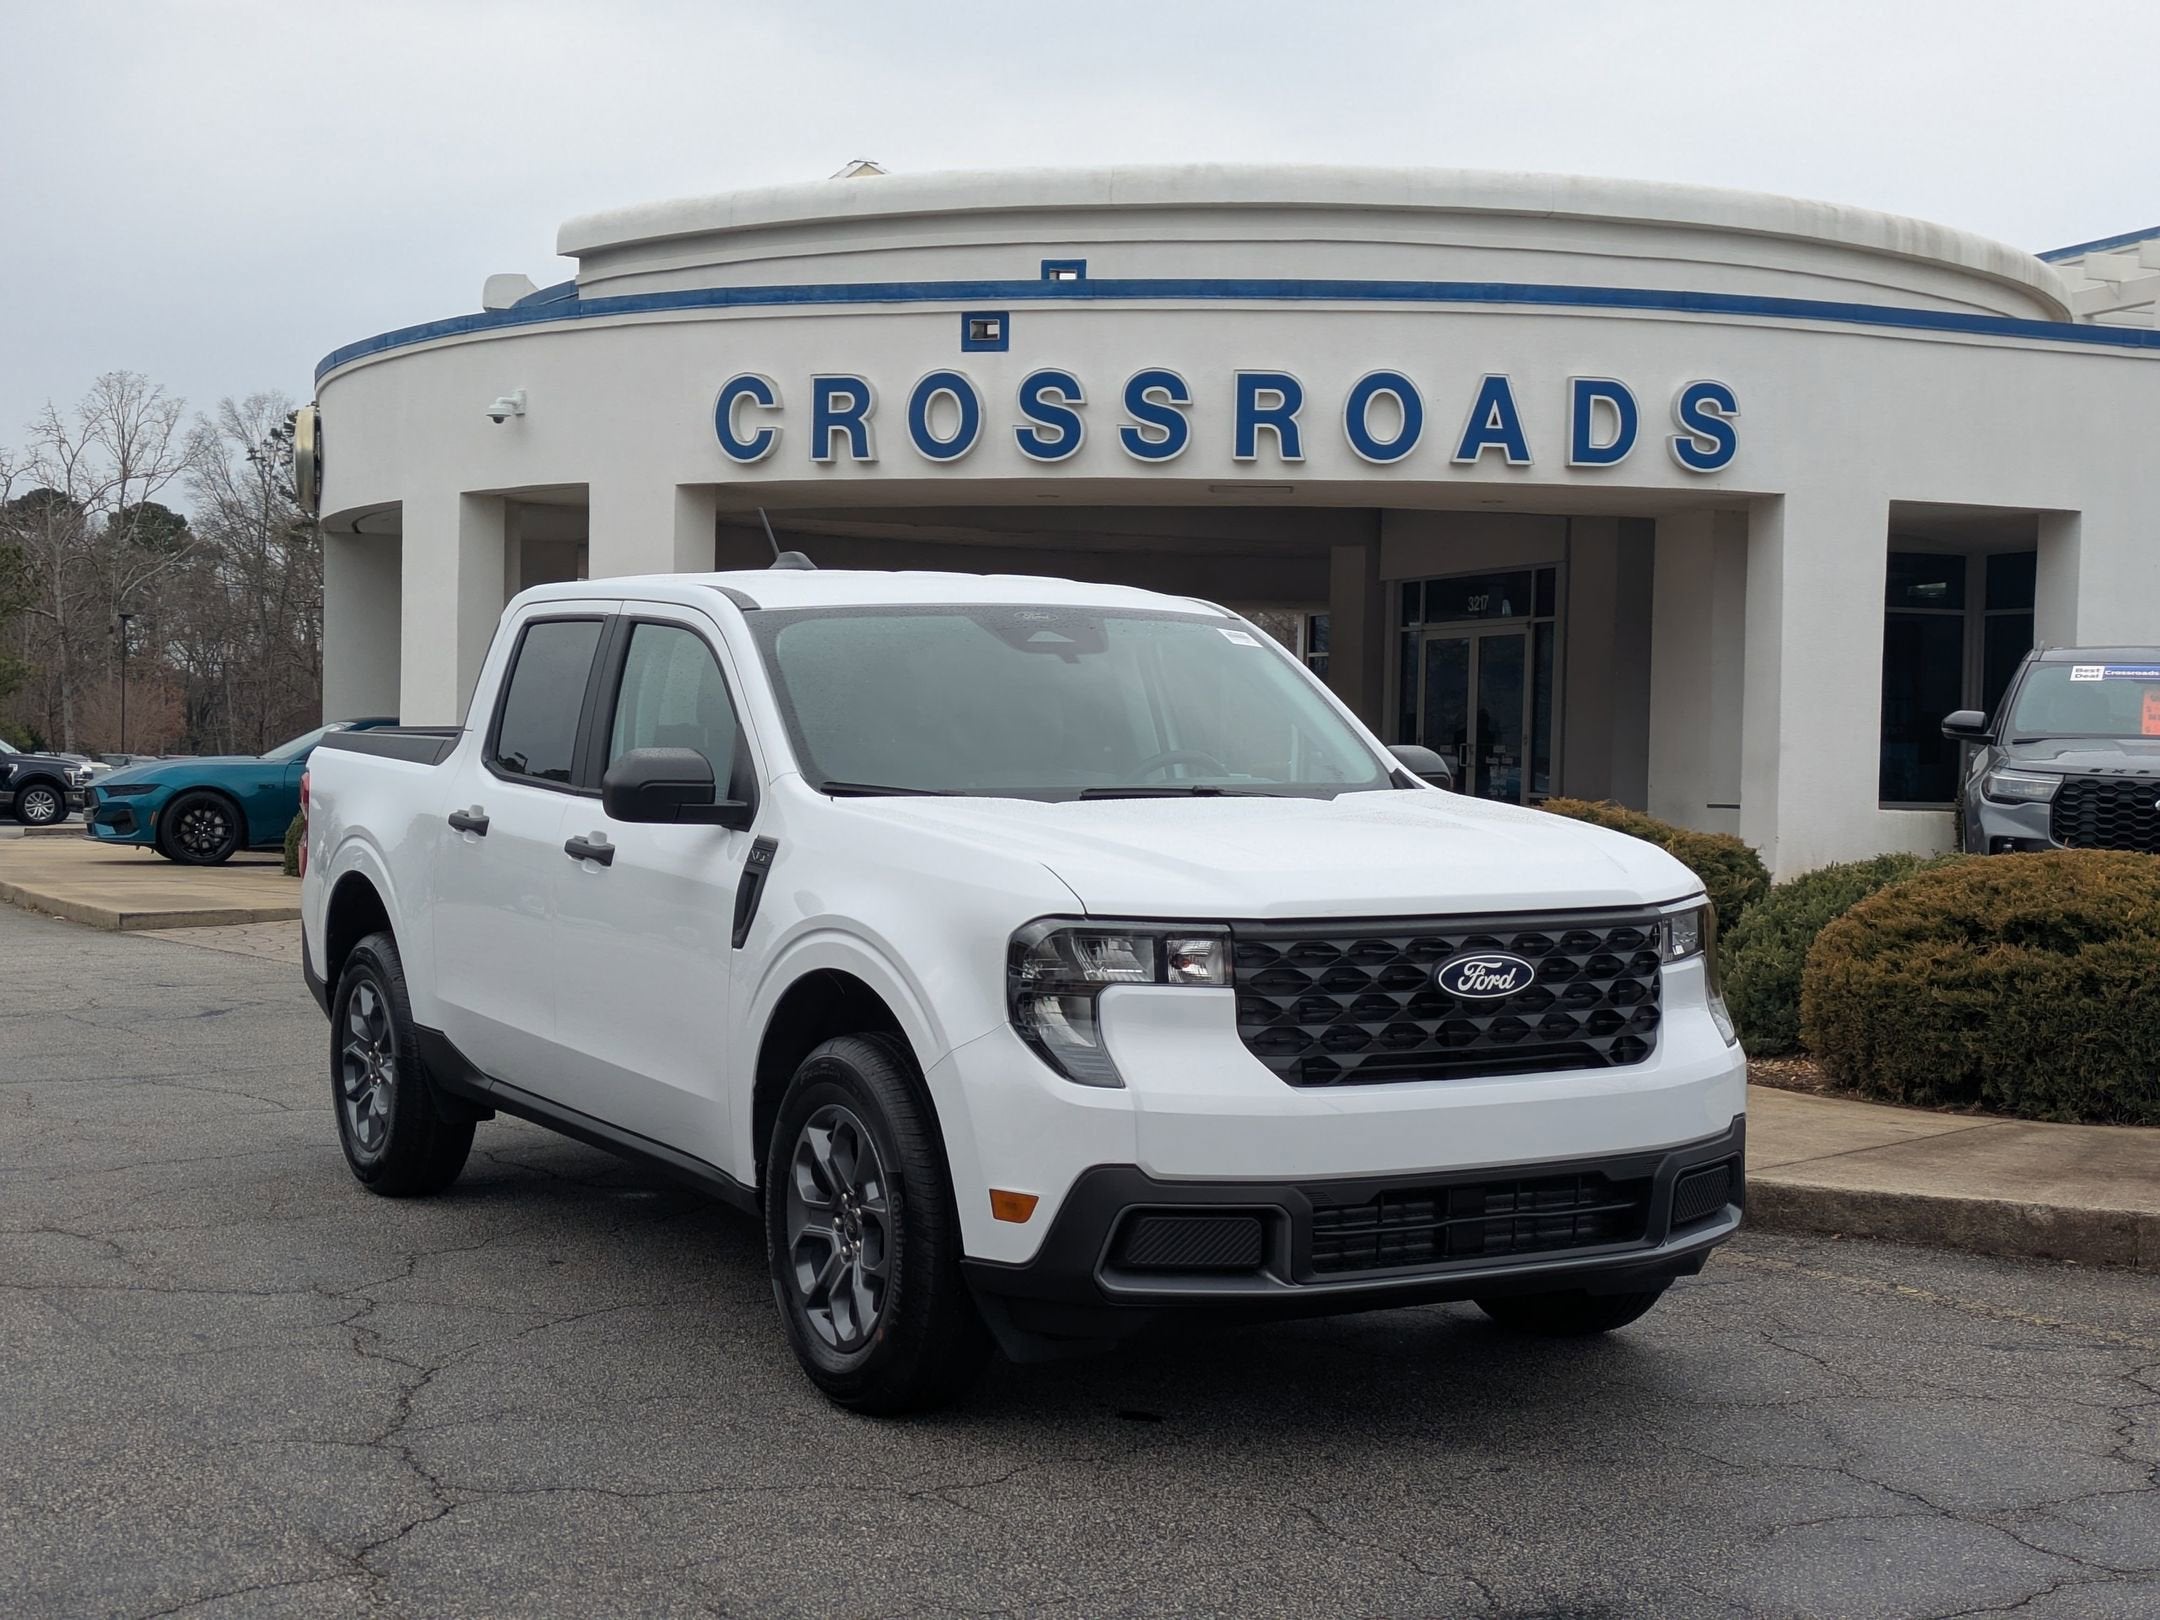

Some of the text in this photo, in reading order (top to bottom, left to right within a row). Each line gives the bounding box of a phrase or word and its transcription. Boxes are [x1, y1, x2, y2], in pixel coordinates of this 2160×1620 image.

[713, 367, 1741, 473] CROSSROADS
[1467, 594, 1489, 611] 3217
[1457, 961, 1517, 991] Ford
